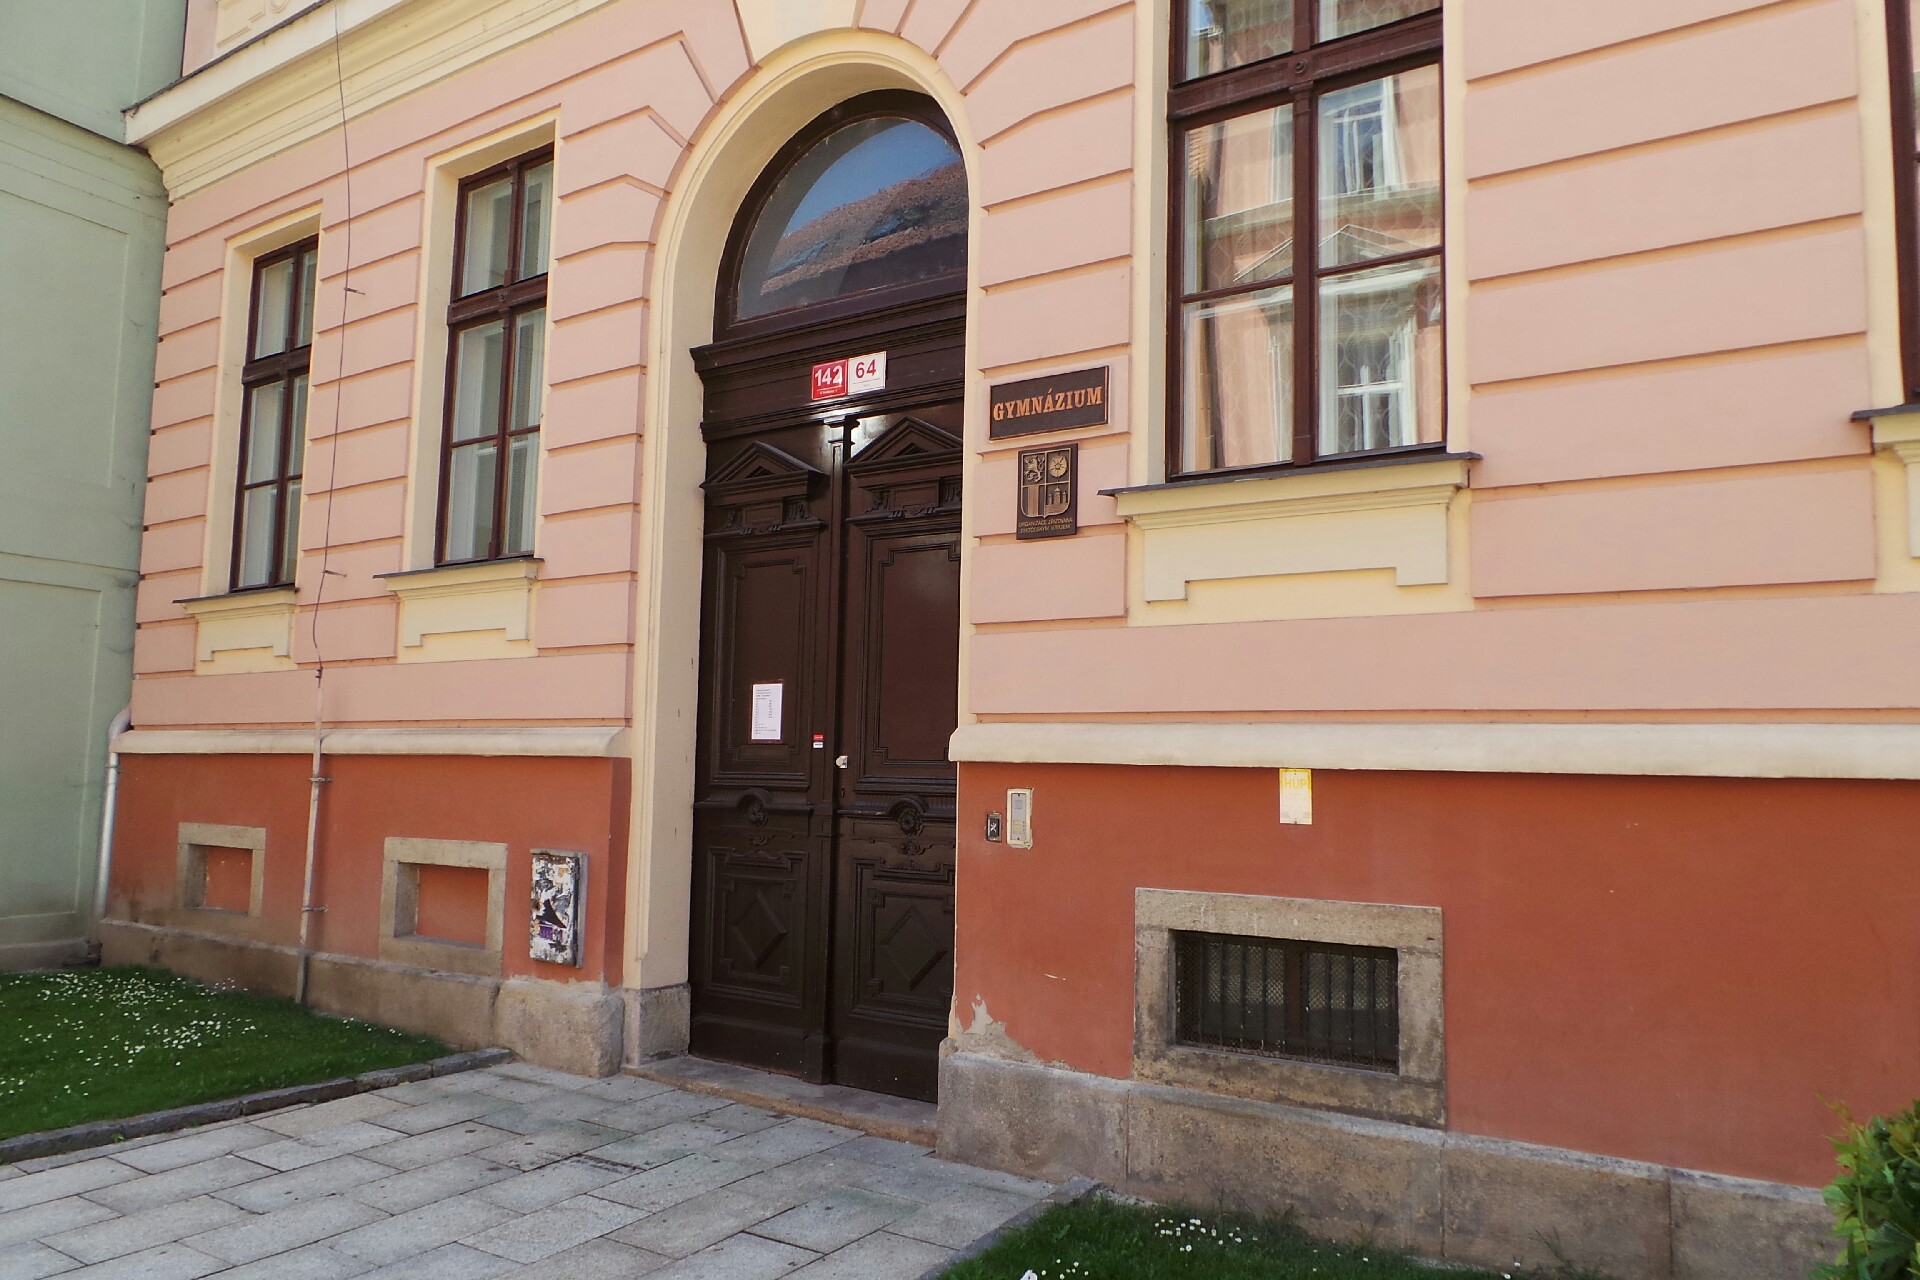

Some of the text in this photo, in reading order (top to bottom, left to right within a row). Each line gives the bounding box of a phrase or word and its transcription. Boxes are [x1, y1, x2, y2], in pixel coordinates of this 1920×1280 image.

[815, 365, 843, 387] 142
[856, 359, 876, 379] 64
[993, 387, 1102, 421] GYMNÁZIUM
[1284, 778, 1306, 789] HUP
